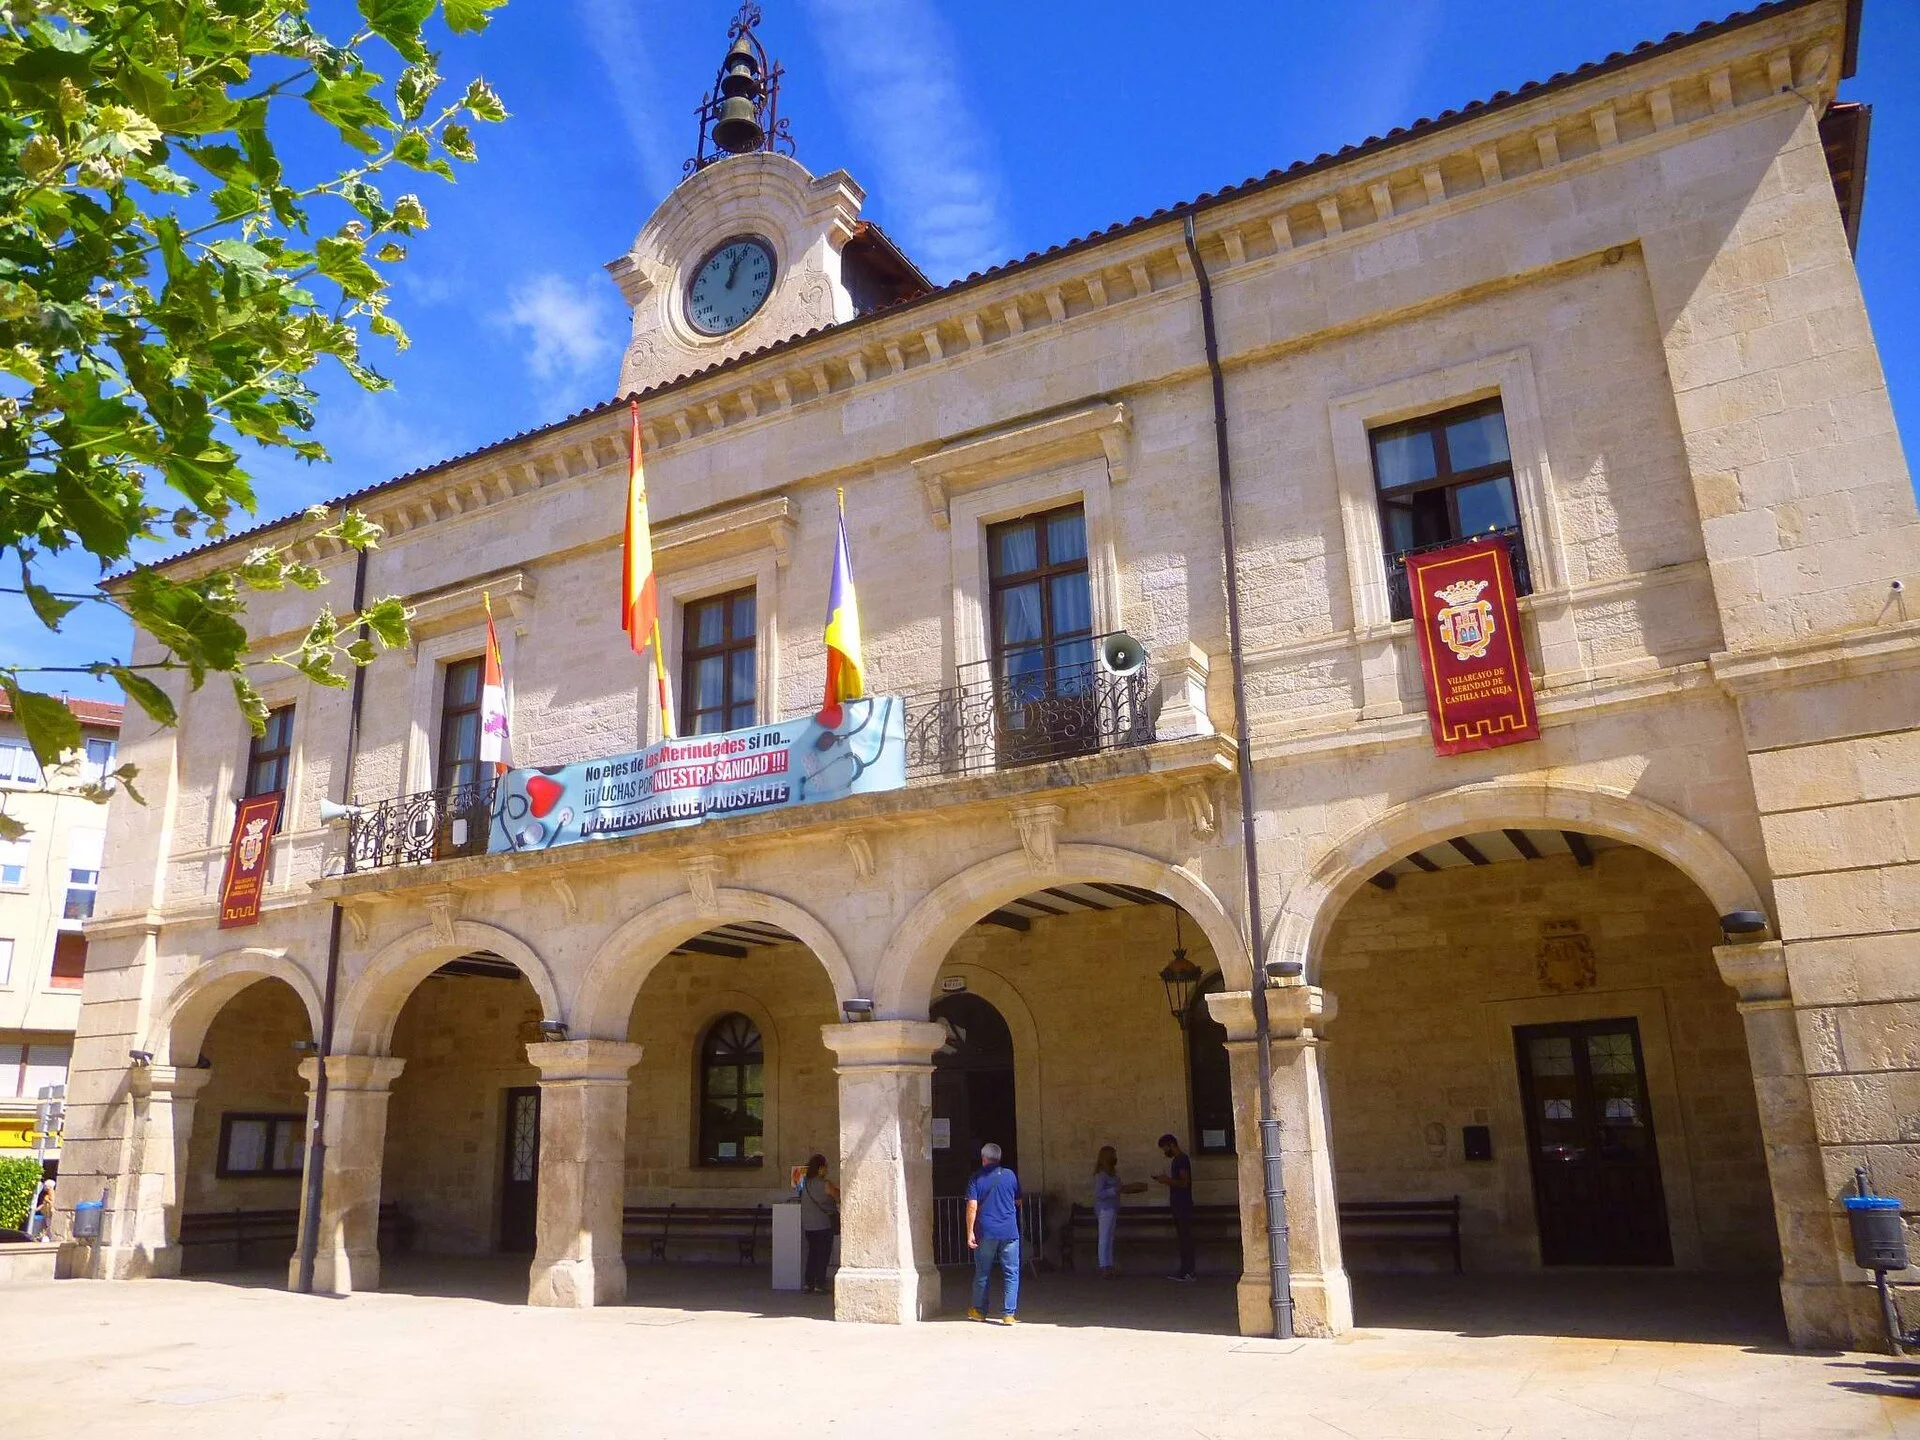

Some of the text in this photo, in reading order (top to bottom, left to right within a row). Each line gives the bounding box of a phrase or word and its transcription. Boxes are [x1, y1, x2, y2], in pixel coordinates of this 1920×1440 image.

[1447, 667, 1505, 685] VILLARCAYO DE
[1451, 677, 1503, 694] MERINDAD DE
[1445, 685, 1513, 704] CASTILLA LA VIEJA
[585, 767, 600, 782] No
[603, 762, 628, 778] eres
[630, 758, 644, 773] de
[660, 738, 746, 763] Merindades
[748, 733, 760, 750] si
[763, 732, 791, 747] no...
[654, 765, 714, 790] NUESTRA
[714, 755, 769, 780] SANIDAD
[639, 801, 669, 823] PARA
[670, 795, 700, 817] QUE
[746, 782, 786, 805] FALTE
